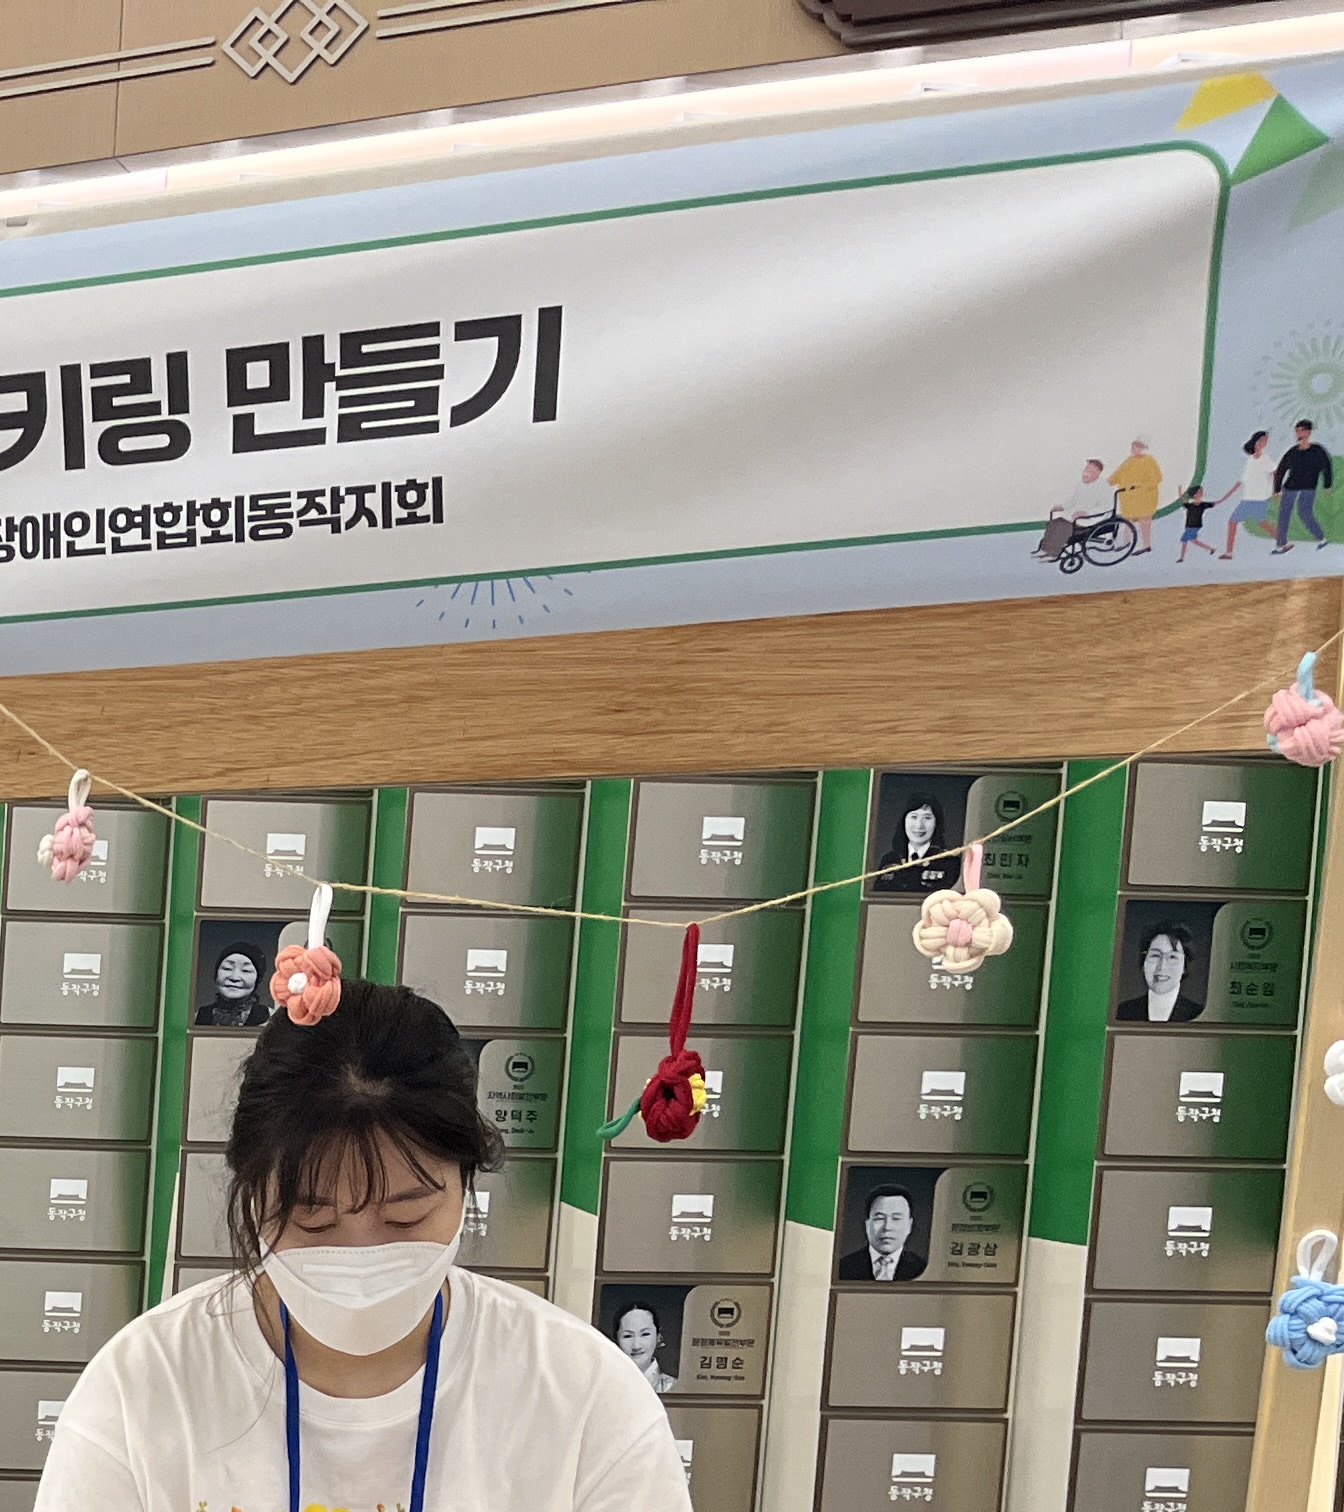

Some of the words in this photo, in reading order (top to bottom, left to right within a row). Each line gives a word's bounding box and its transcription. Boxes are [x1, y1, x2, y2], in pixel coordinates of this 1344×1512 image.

[226, 306, 563, 455] 만들기
[1199, 836, 1243, 853] 동작구청
[77, 868, 108, 883] 작구청
[264, 859, 303, 877] 동작구청
[61, 978, 99, 996] 동작구청
[464, 976, 505, 995] 동작구청
[699, 976, 732, 991] 작구청
[918, 1104, 962, 1119] 동작구청
[47, 1208, 86, 1220] 동작구청
[669, 1226, 711, 1240] 동작구청
[1165, 1241, 1209, 1256] 동작구청
[1153, 1371, 1198, 1387] 동작구청
[888, 1486, 933, 1501] 동작구청
